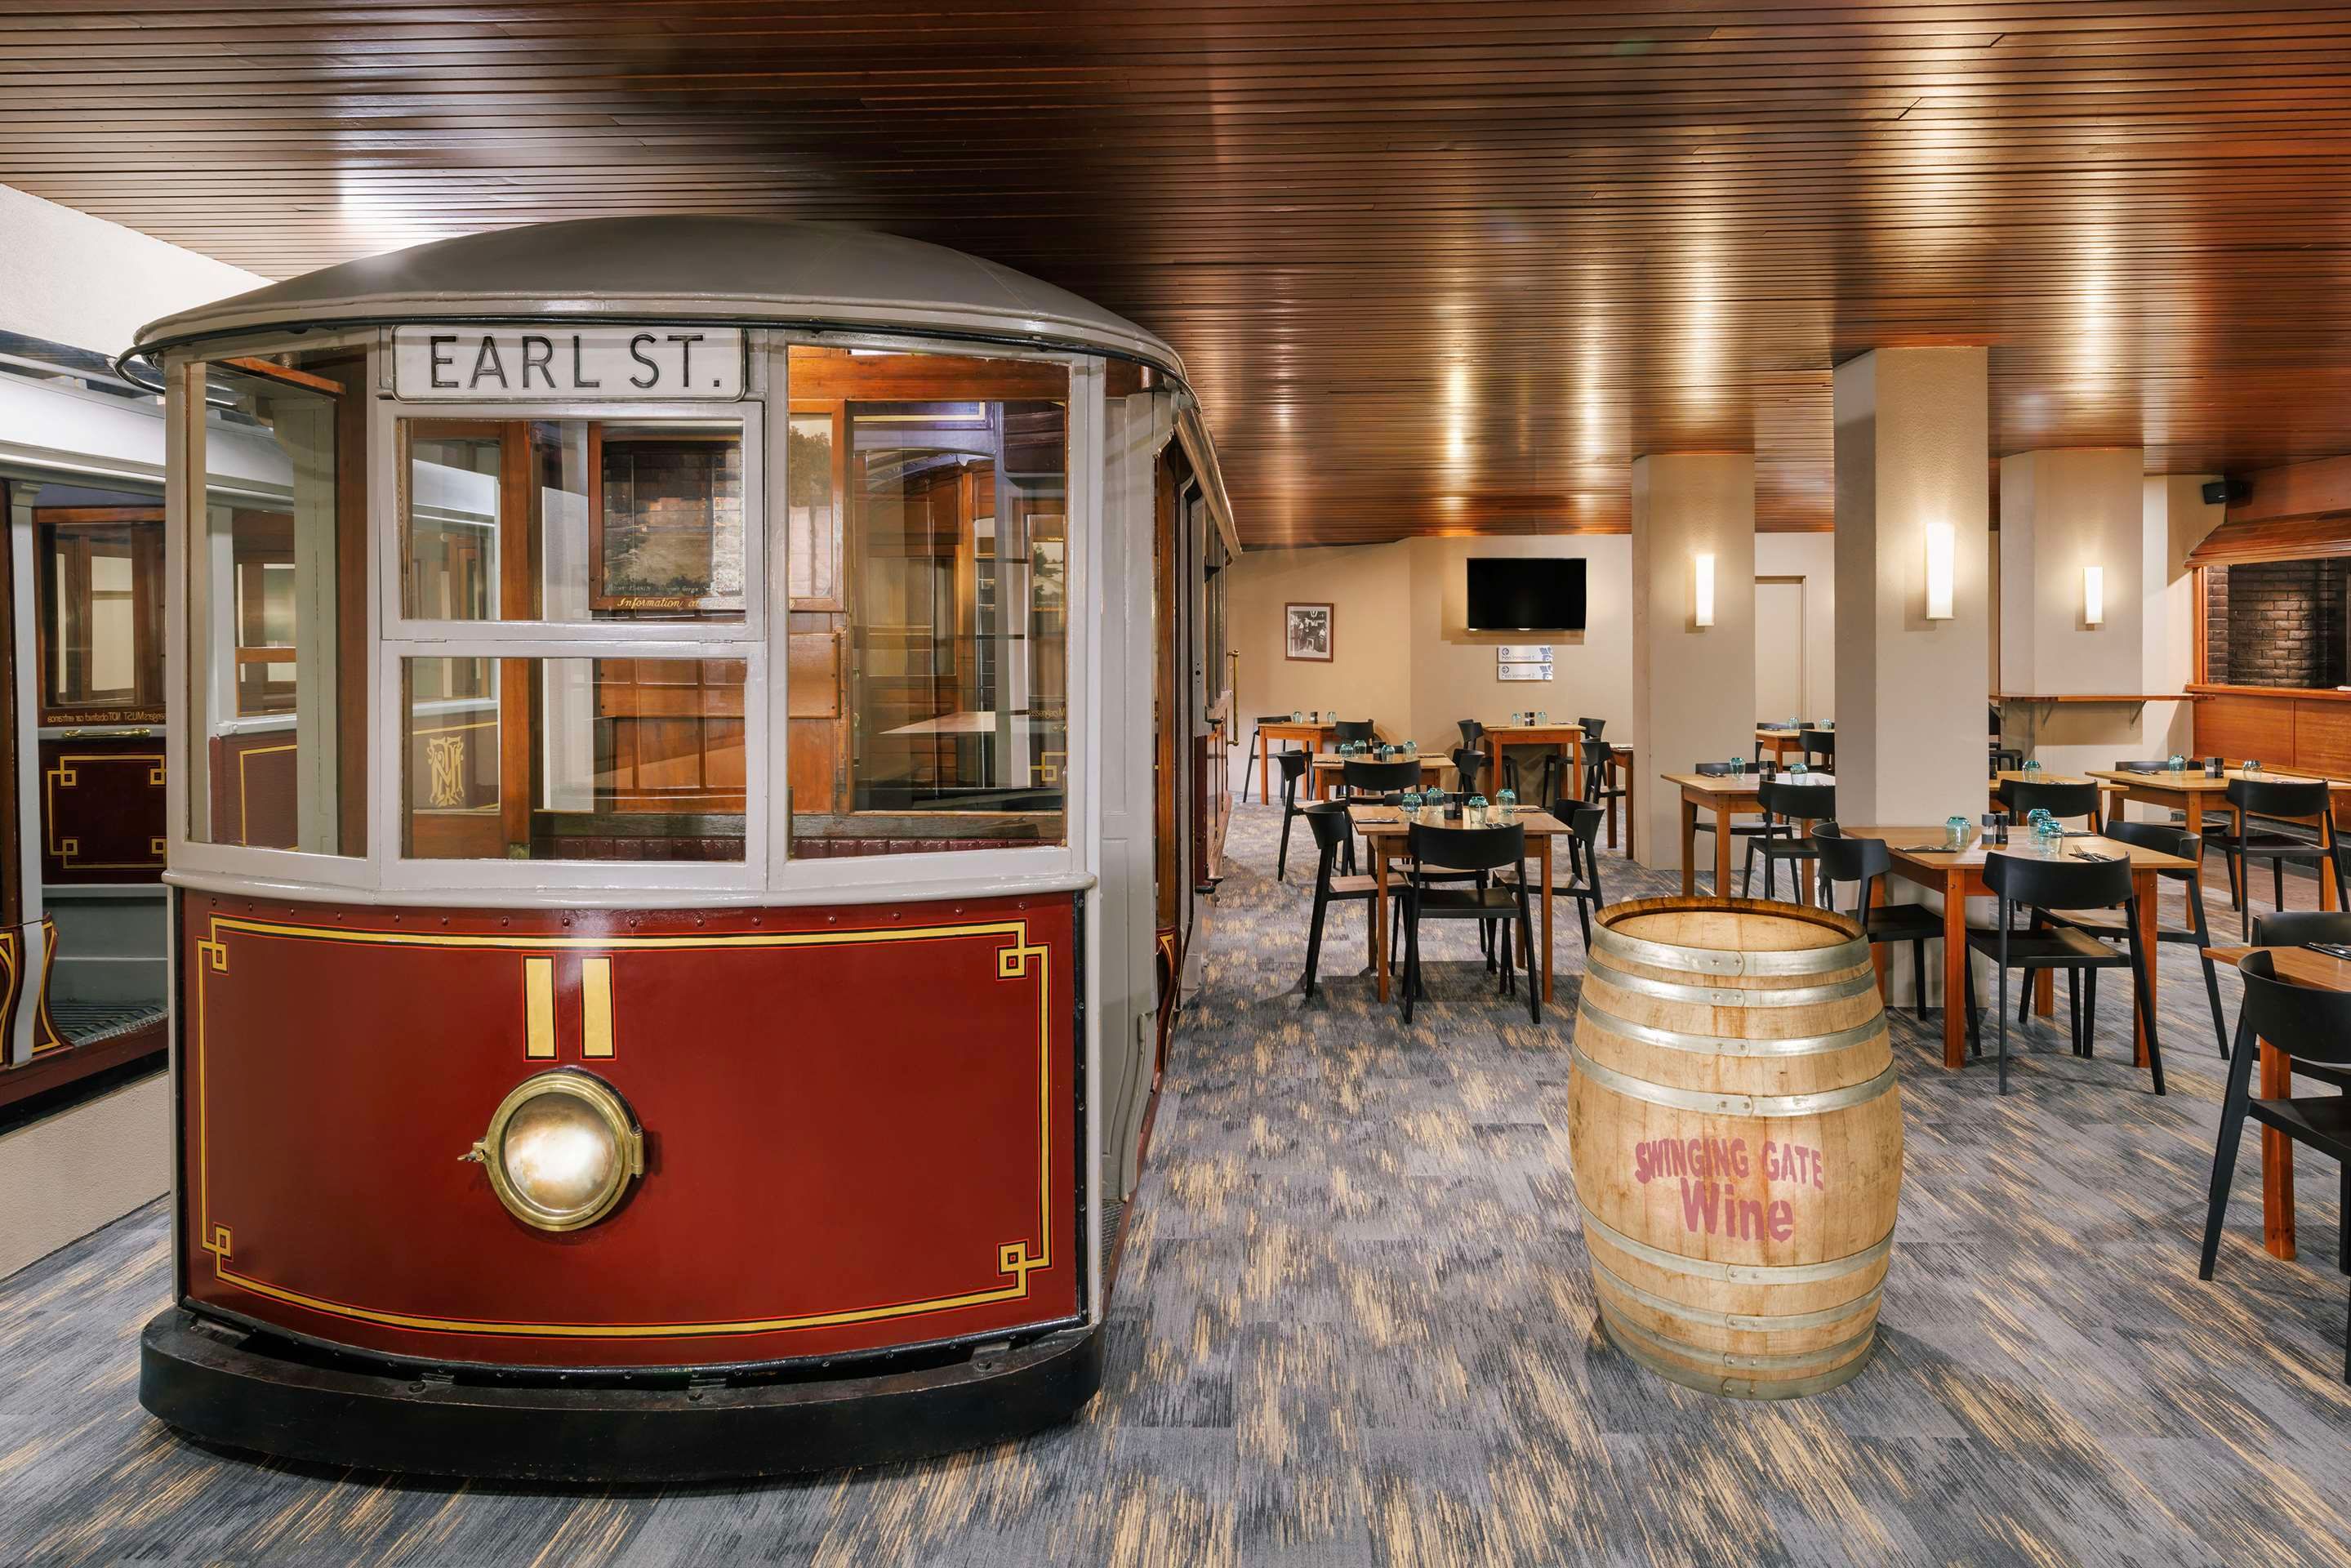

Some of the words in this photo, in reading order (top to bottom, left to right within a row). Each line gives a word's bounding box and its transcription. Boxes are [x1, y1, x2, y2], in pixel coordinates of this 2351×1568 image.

[430, 333, 601, 390] EARL
[629, 333, 722, 390] ST.
[617, 597, 684, 609] Information
[1634, 1137, 1750, 1184] SWINGING
[1761, 1140, 1824, 1191] GATE
[1680, 1177, 1794, 1243] Wine
